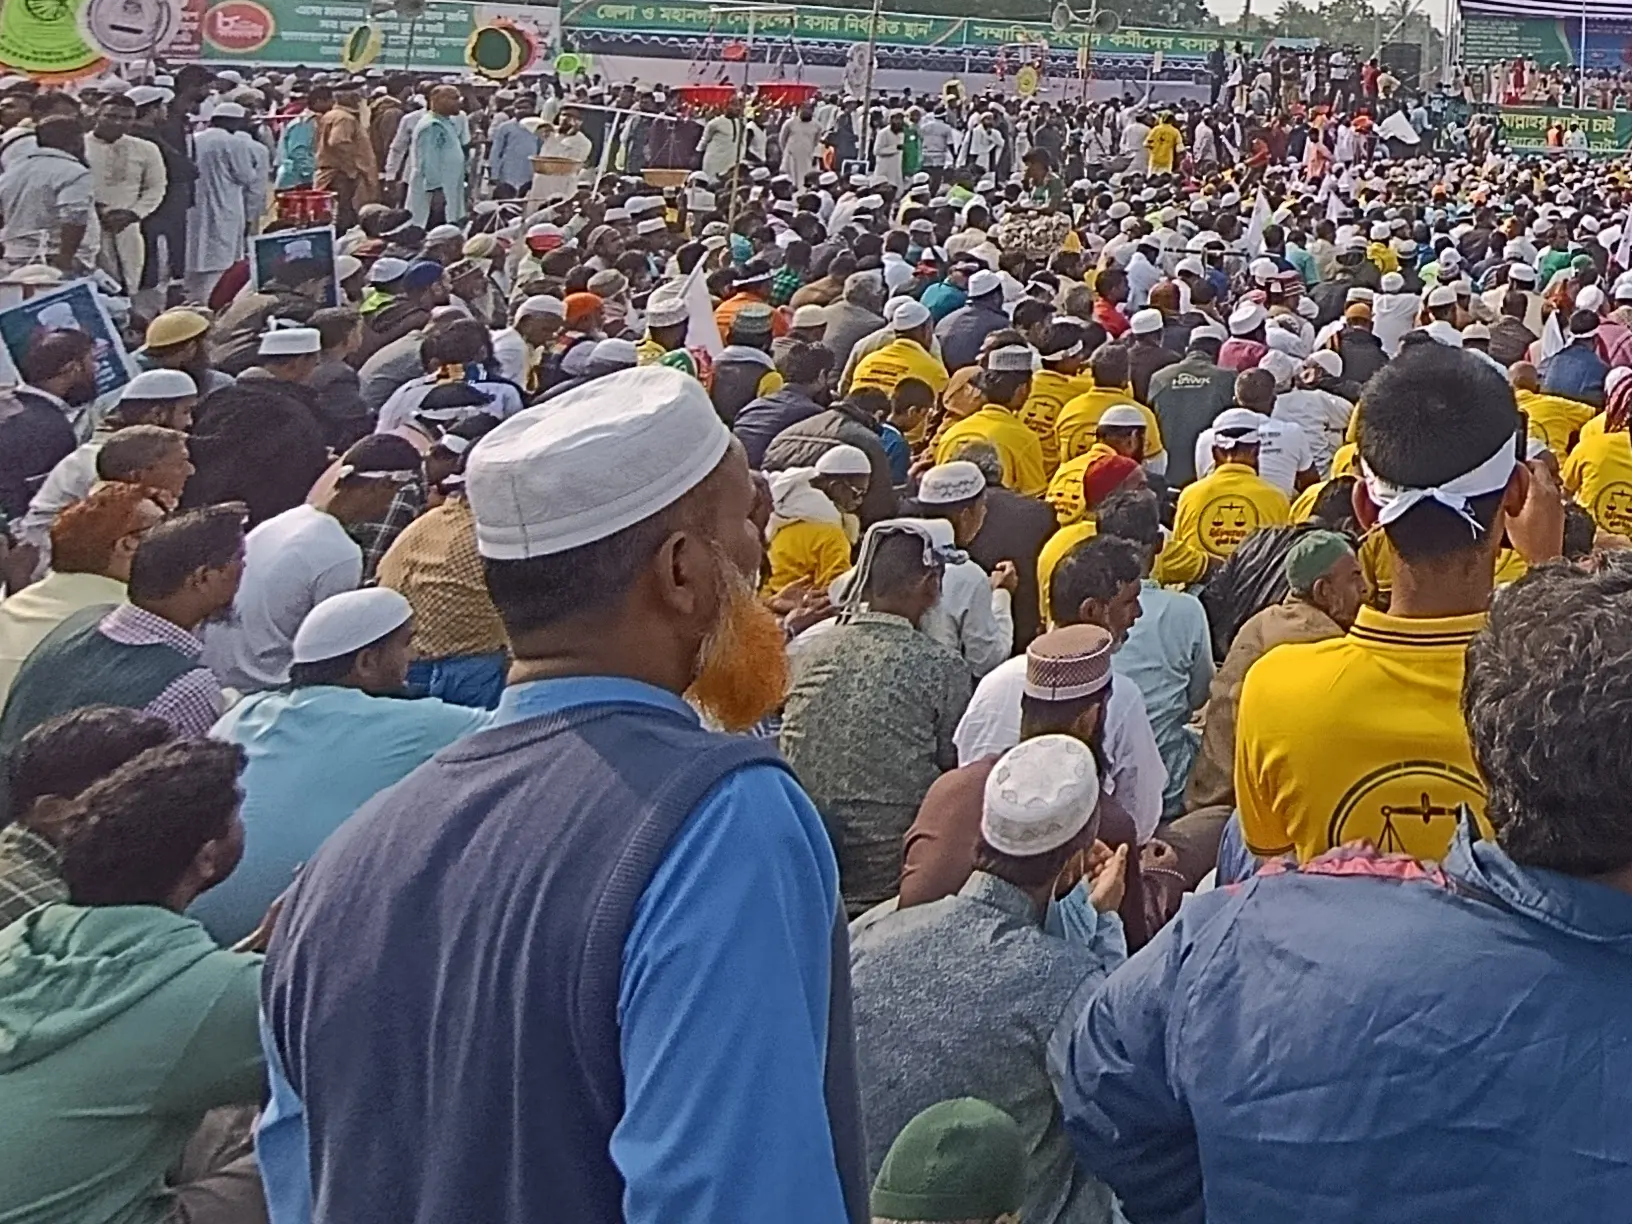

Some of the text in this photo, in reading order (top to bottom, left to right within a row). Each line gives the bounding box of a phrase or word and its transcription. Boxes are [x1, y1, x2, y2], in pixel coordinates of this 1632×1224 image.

[597, 3, 637, 21] জেলা
[642, 7, 655, 20] ও
[804, 14, 841, 32] বসার
[1592, 116, 1616, 134] চাই
[1171, 374, 1212, 386] HAWK
